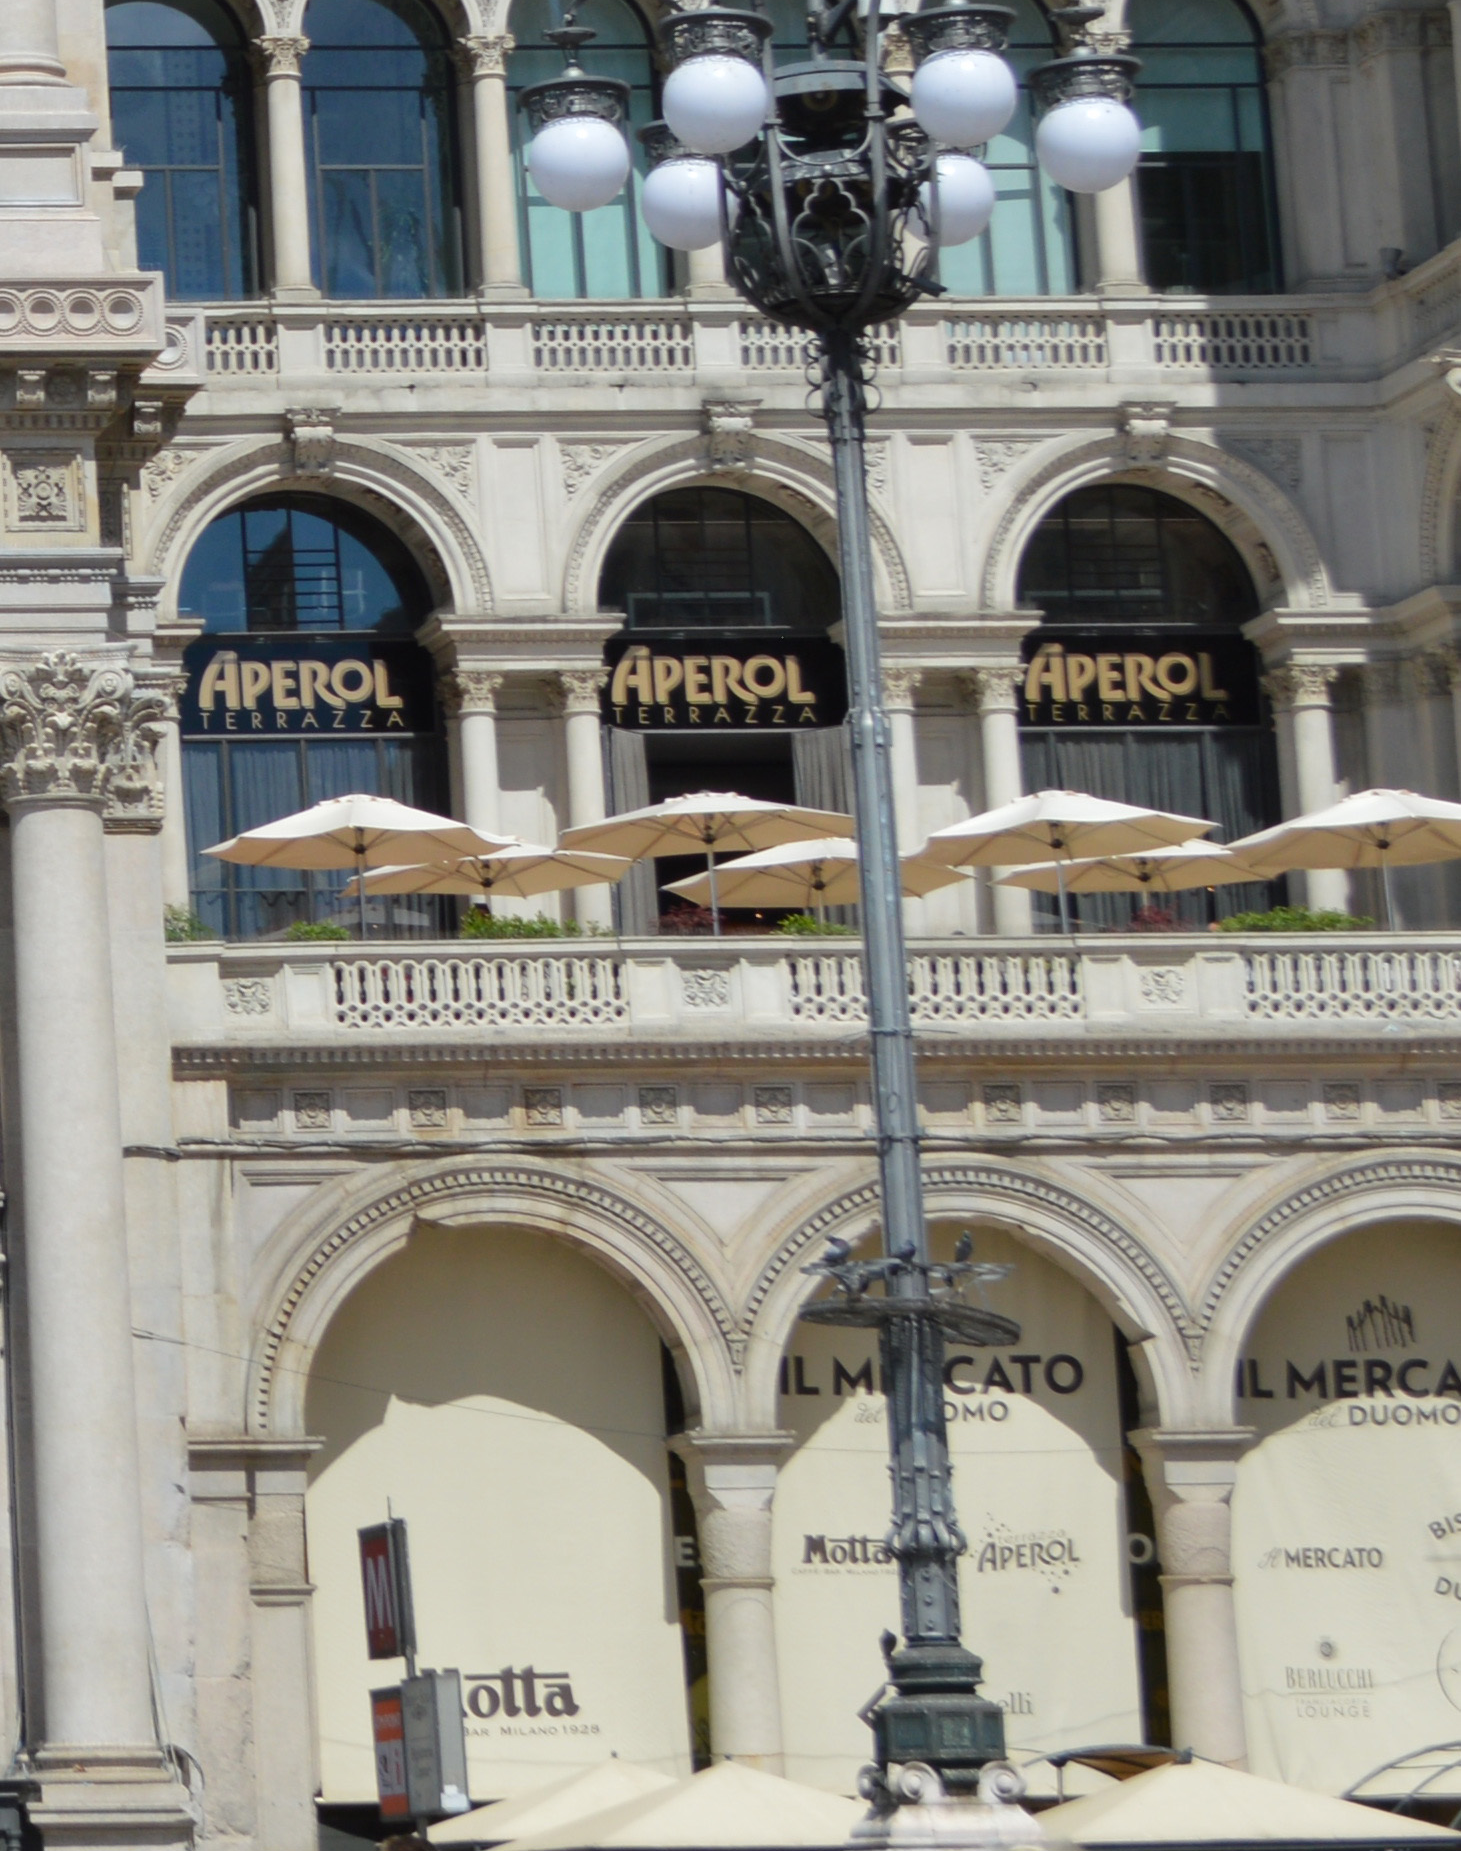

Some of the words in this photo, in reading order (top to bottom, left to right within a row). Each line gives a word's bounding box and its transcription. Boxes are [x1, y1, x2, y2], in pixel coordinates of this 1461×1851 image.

[198, 650, 403, 710] APEROL
[611, 645, 817, 705] APEROL
[1024, 642, 1229, 702] APEROL
[199, 710, 404, 730] TERRAZZA
[612, 706, 818, 724] TERRAZZA
[1026, 703, 1231, 721] TERRAZZA
[778, 1356, 819, 1395] IL
[832, 1354, 1084, 1395] MCATO
[1236, 1358, 1274, 1398] IL
[1348, 1403, 1461, 1426] DUOMO
[976, 1538, 1081, 1573] APEROL
[1284, 1546, 1384, 1569] MERCATO
[365, 1554, 393, 1630] M
[461, 1665, 581, 1718] otta
[1285, 1666, 1375, 1689] BERLUCCHI
[1296, 1705, 1372, 1719] LOUNGE
[500, 1725, 558, 1736] MILANO
[562, 1723, 601, 1735] 1928
